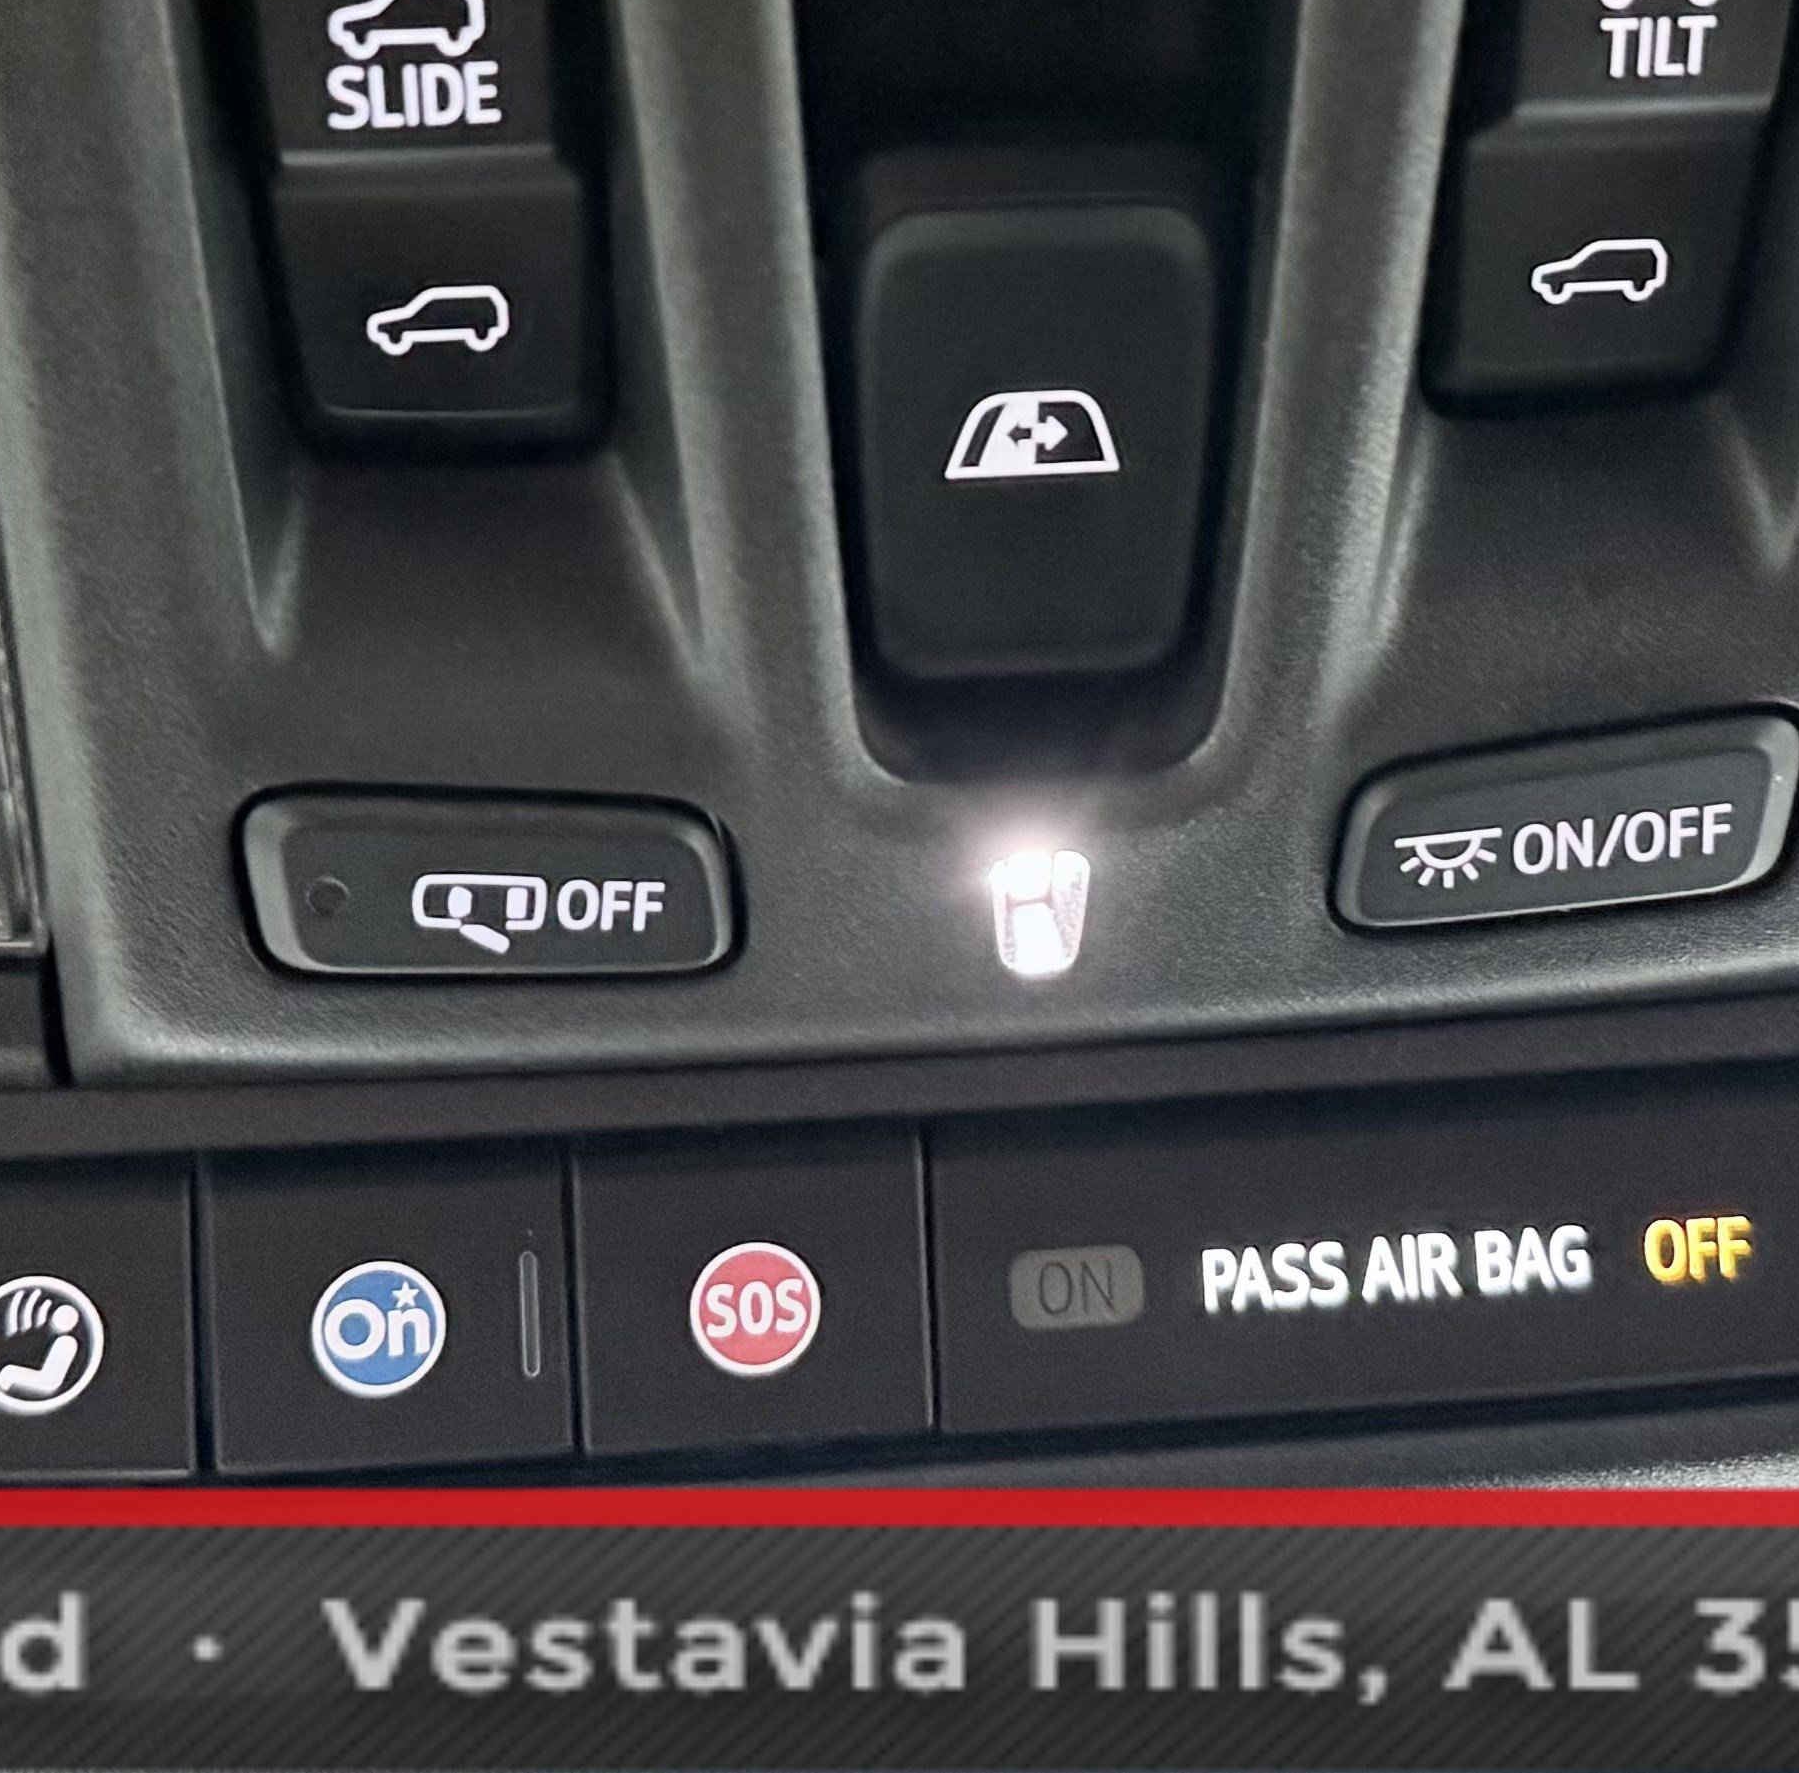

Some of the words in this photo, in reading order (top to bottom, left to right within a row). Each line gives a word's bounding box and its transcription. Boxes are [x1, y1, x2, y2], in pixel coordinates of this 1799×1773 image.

[1599, 14, 1719, 79] TILT
[326, 59, 502, 130] SLIDE
[1512, 802, 1733, 875] ON/OFF
[556, 879, 667, 932] OFF
[1036, 1259, 1116, 1316] ON
[1201, 1240, 1350, 1315] PASS
[1361, 1231, 1463, 1305] AIR
[1473, 1224, 1594, 1297] BAG
[1642, 1214, 1754, 1286] OFF
[705, 1277, 808, 1339] SOS
